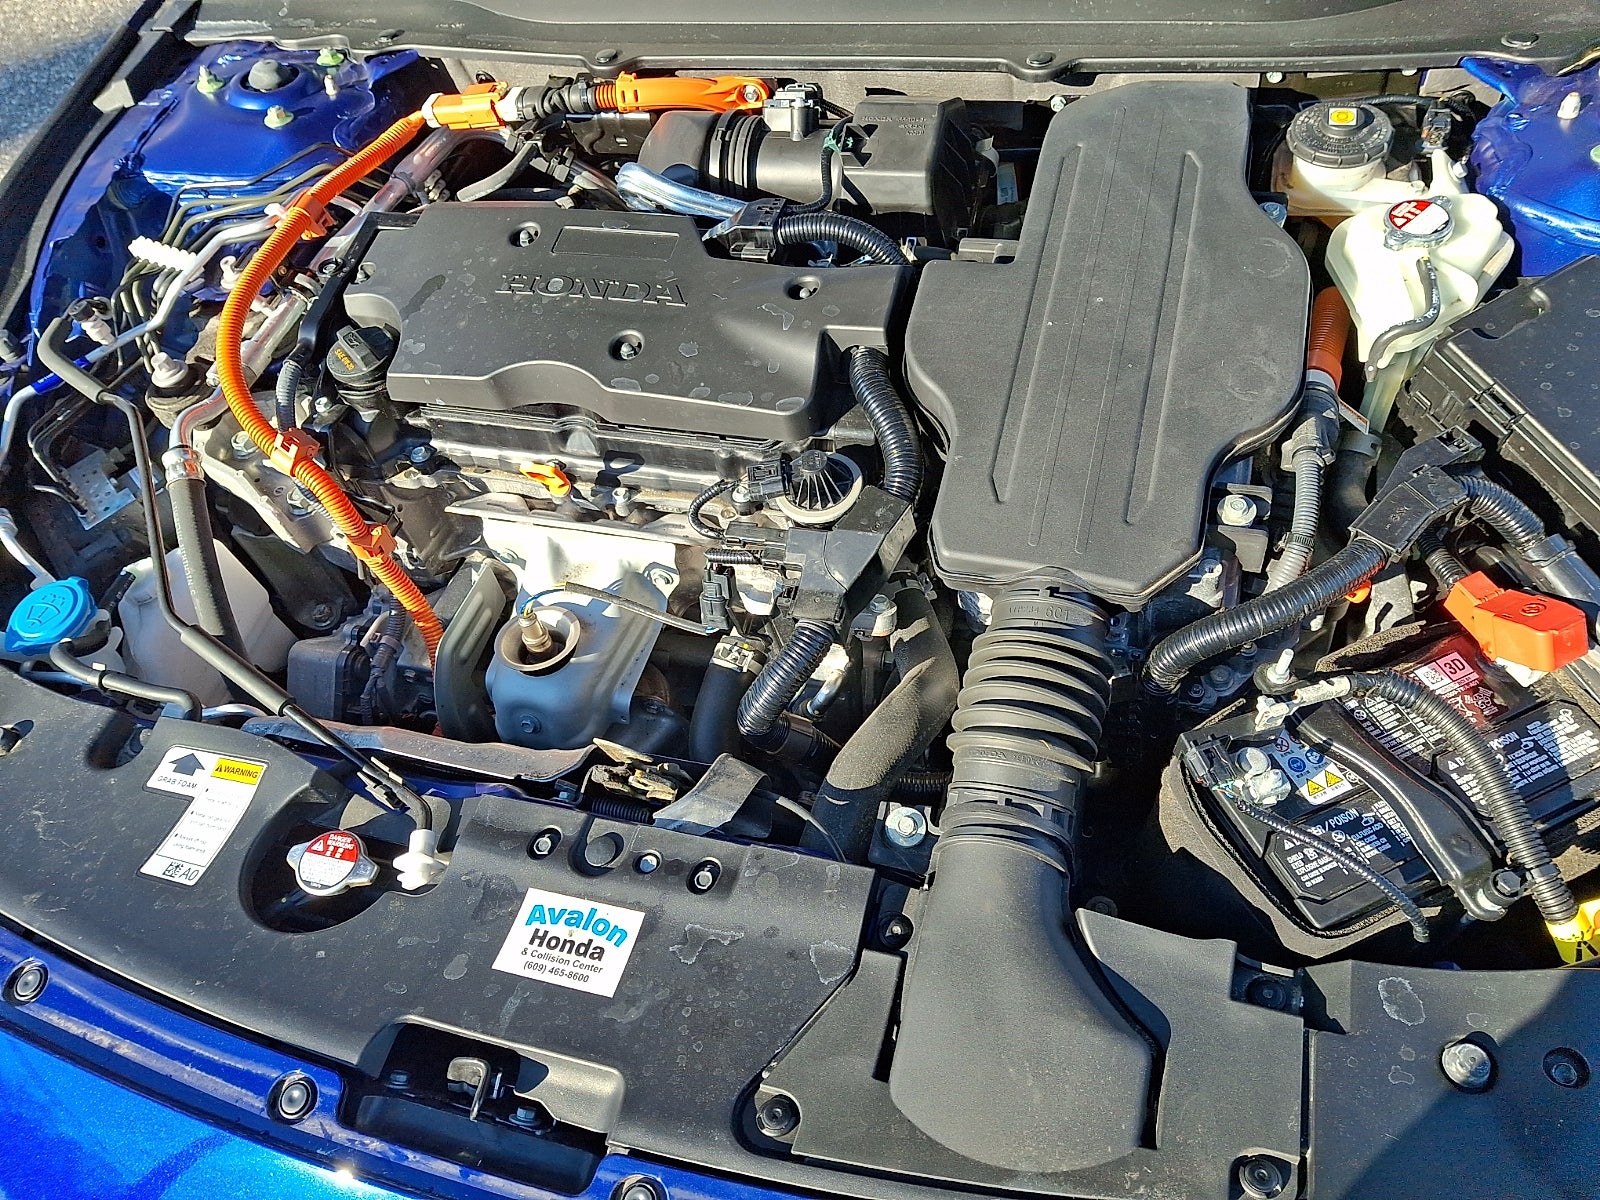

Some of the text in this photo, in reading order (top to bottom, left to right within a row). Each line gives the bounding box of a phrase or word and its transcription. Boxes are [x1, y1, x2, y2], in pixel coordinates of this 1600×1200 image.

[494, 274, 688, 307] HONDA
[1443, 658, 1466, 675] 3D
[157, 775, 198, 789] GRAB FOAM
[223, 766, 259, 779] WARNING
[1329, 807, 1360, 829] POISON
[525, 904, 628, 948] Avalon
[528, 928, 606, 962] Honda
[521, 947, 604, 974] & Collision Center
[523, 960, 590, 983] (609) 465-8600
